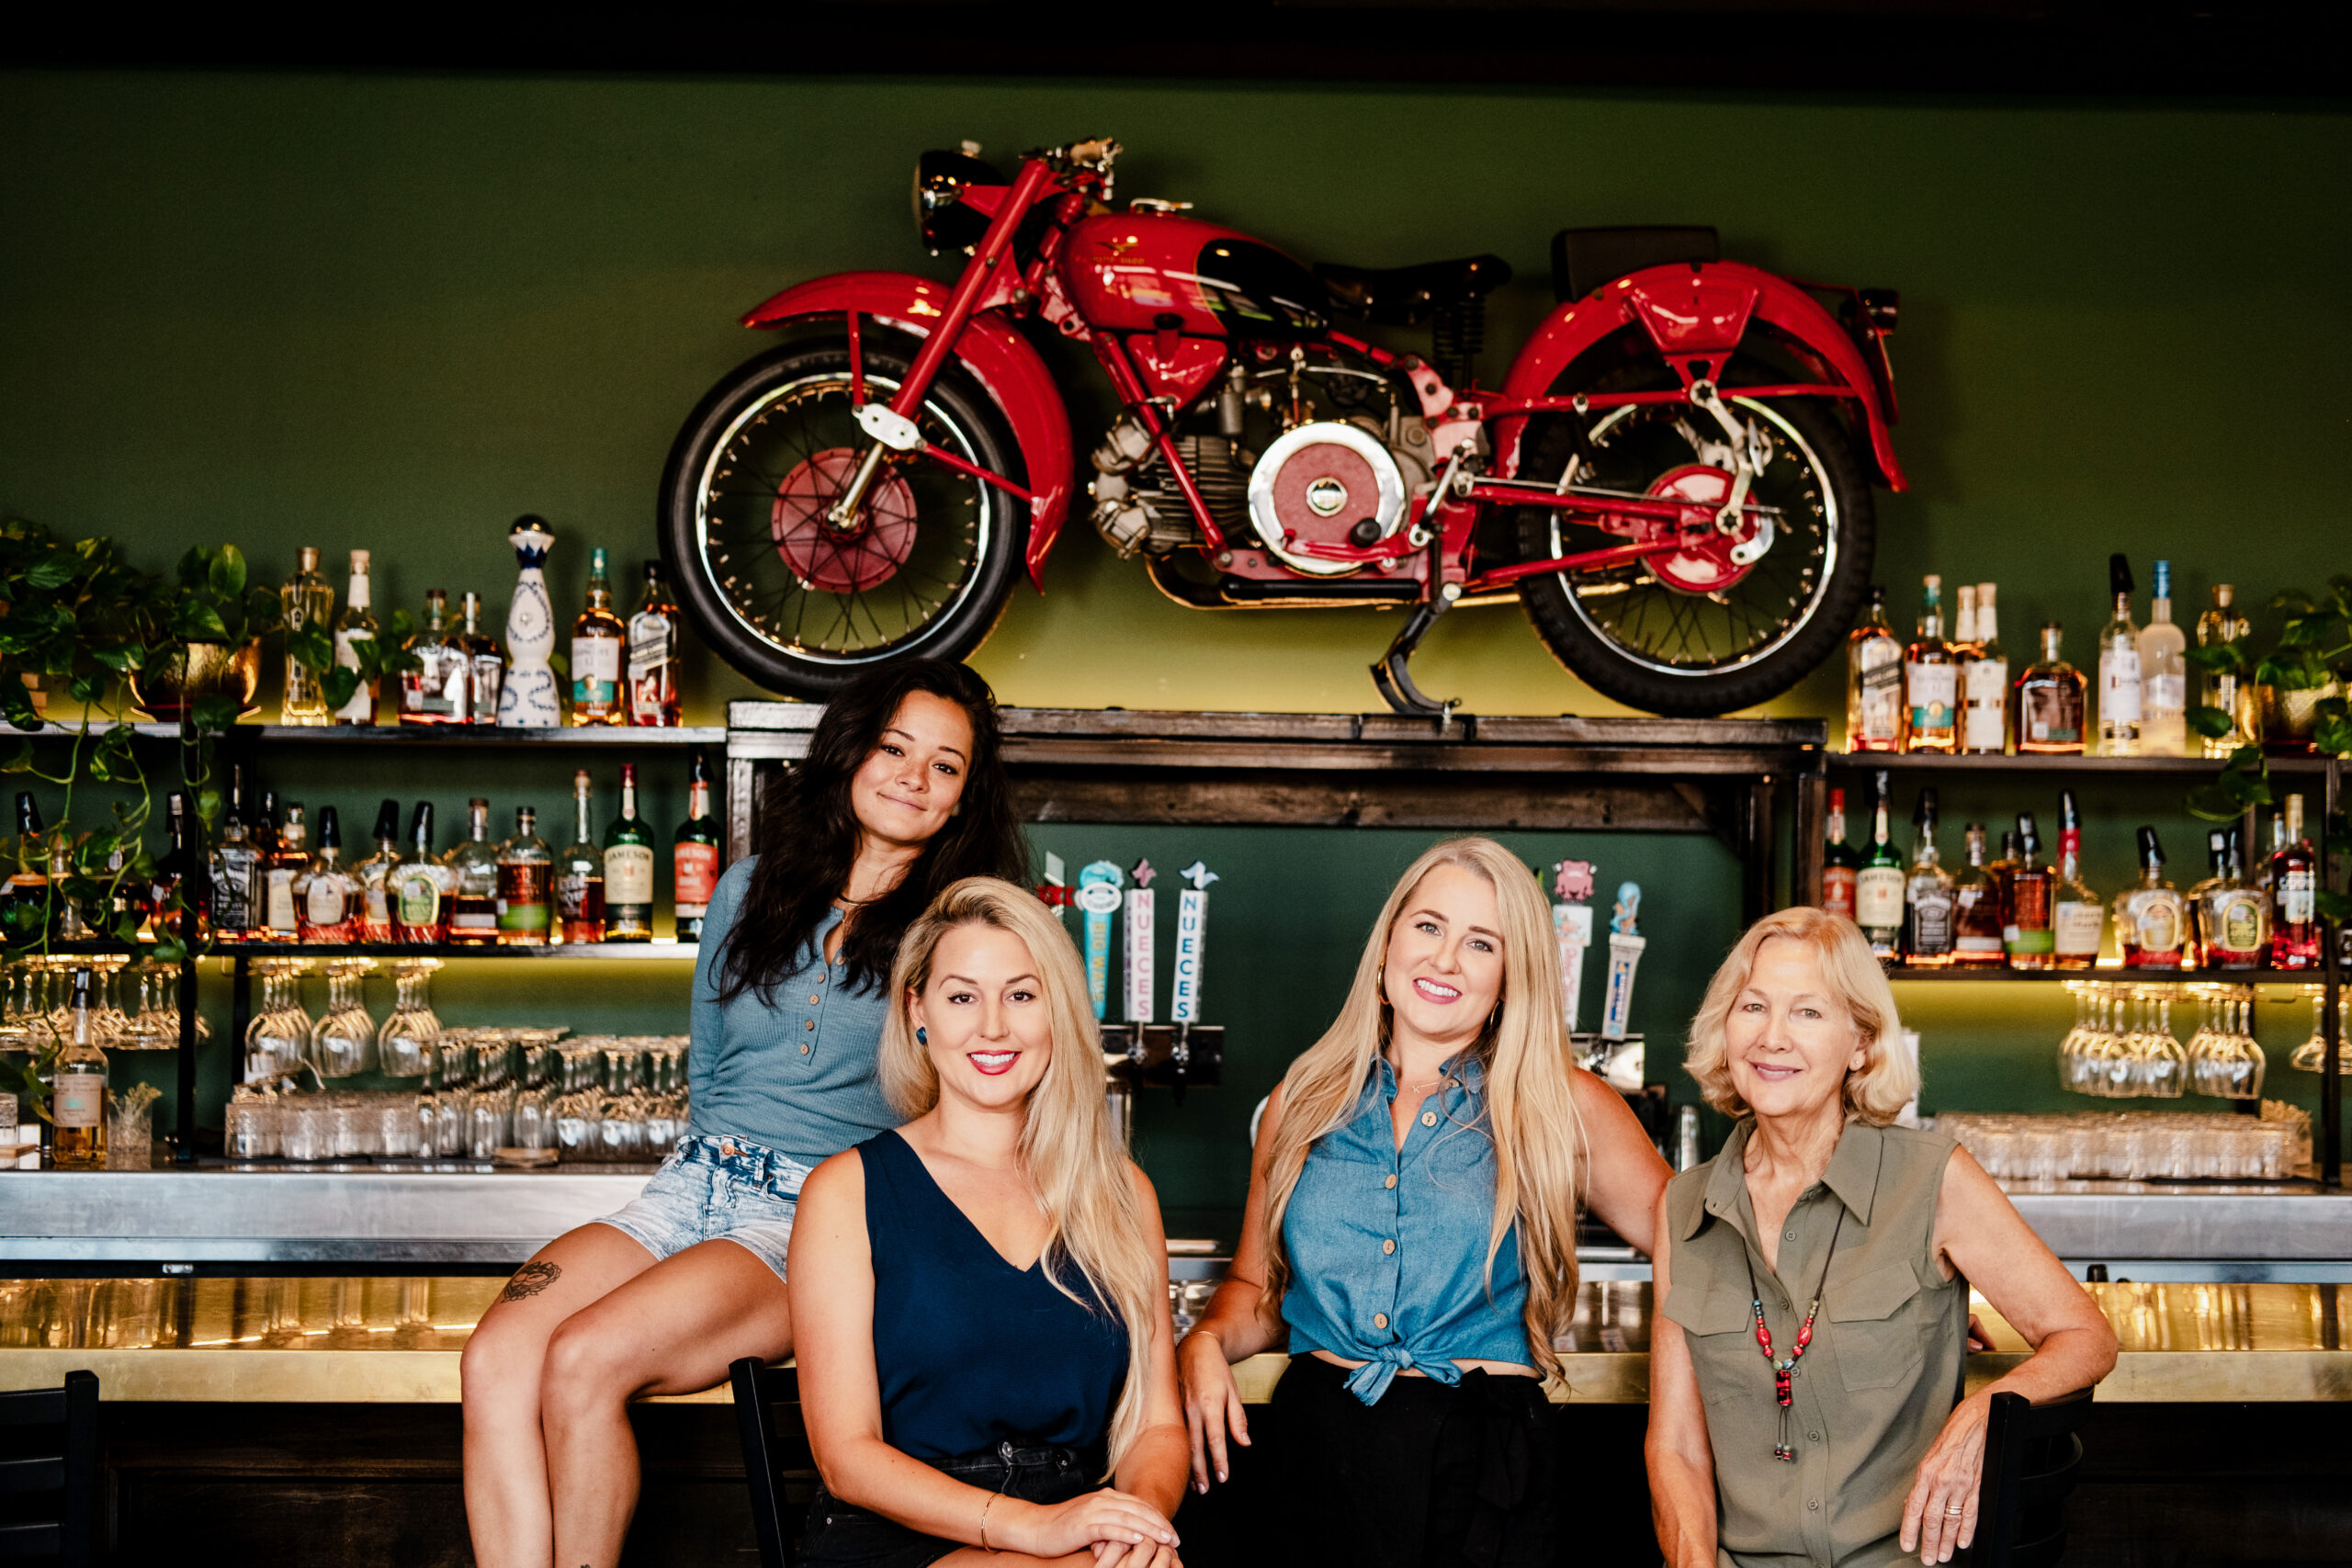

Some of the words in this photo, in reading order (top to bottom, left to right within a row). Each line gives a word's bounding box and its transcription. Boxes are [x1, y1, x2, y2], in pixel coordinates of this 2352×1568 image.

[608, 850, 650, 863] JAMESON
[1092, 922, 1107, 951] BIG
[1136, 893, 1150, 1017] NUECES
[1177, 896, 1197, 1018] NUECES
[1091, 955, 1106, 1002] WAVE
